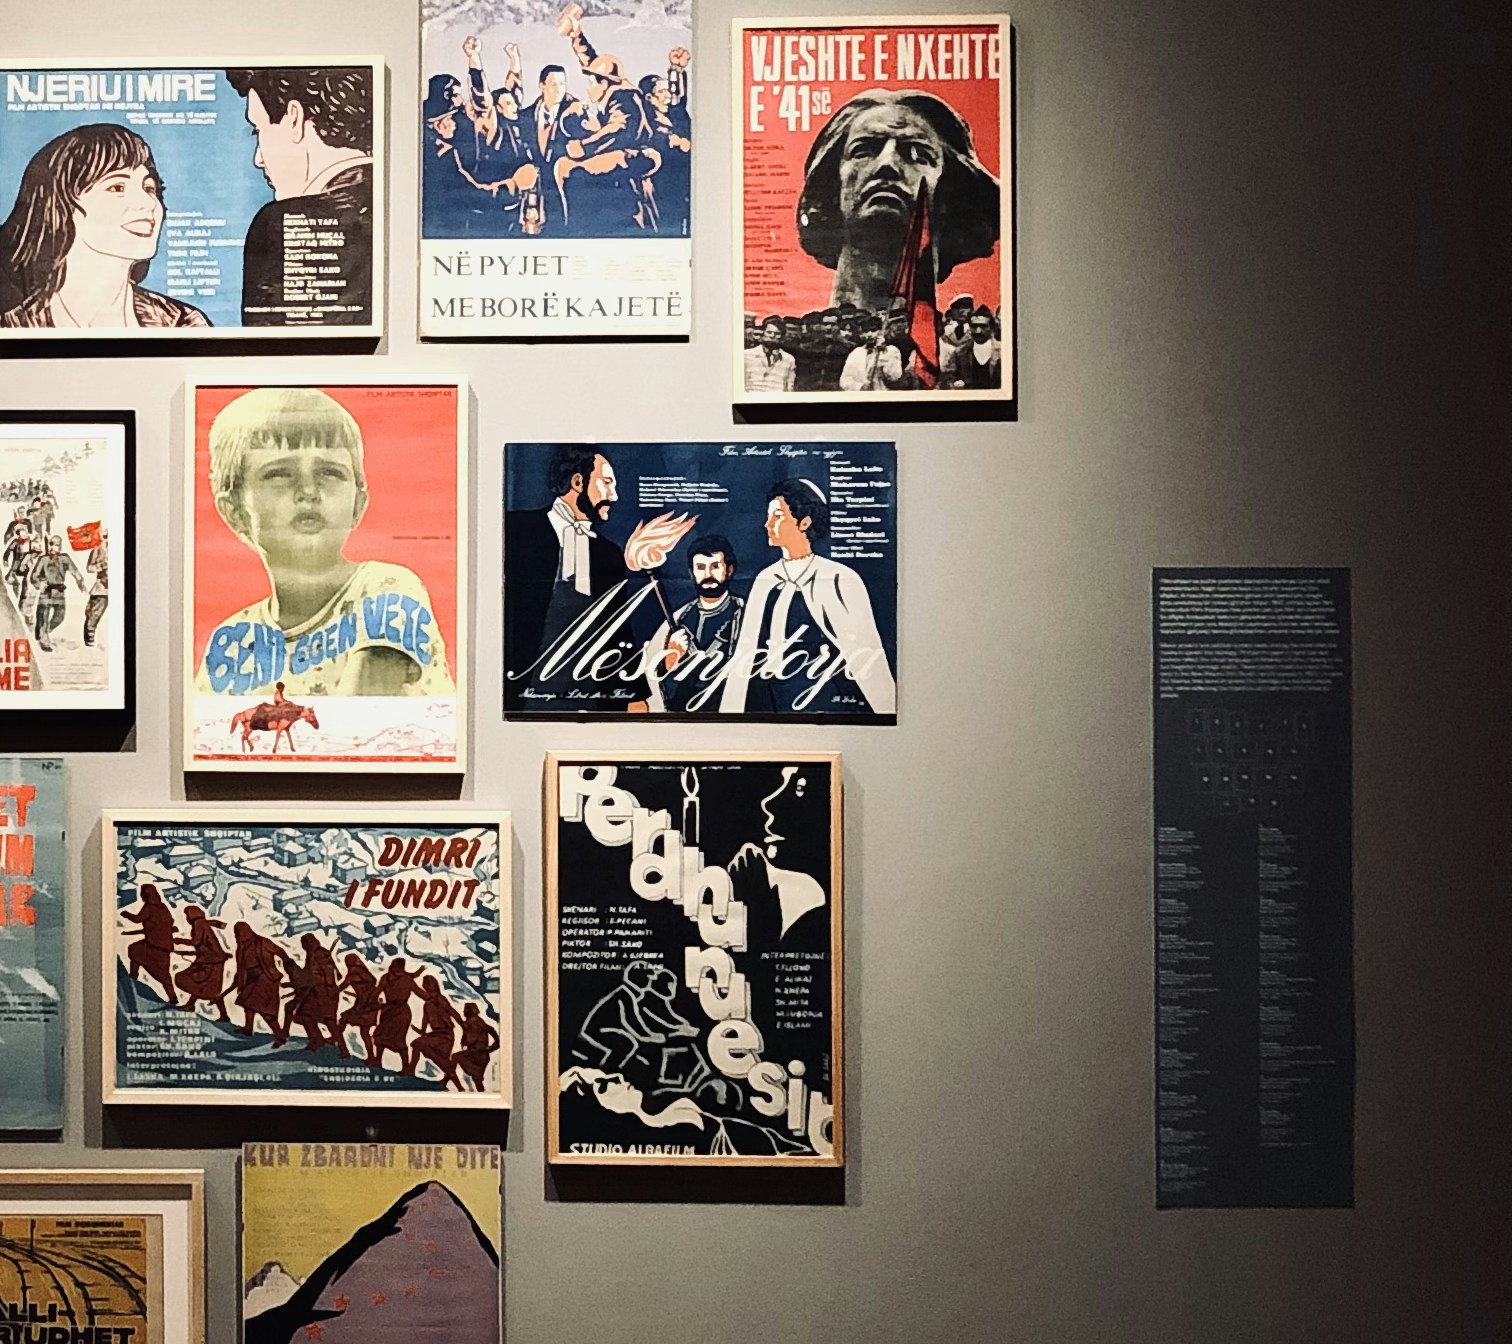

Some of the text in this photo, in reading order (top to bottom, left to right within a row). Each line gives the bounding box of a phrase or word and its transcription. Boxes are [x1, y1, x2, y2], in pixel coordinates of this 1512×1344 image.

[751, 32, 1000, 81] VJESHTE E NXEHTE
[7, 74, 216, 102] NJERIU I MIRE
[750, 86, 764, 132] E
[127, 829, 152, 837] FILM
[155, 829, 199, 837] ARTISTIK
[378, 837, 481, 868] DIMRI
[345, 879, 480, 908] I FUNDIT
[244, 1144, 289, 1167] KUR
[456, 1146, 500, 1170] DITE
[569, 1142, 621, 1155] STUDIO
